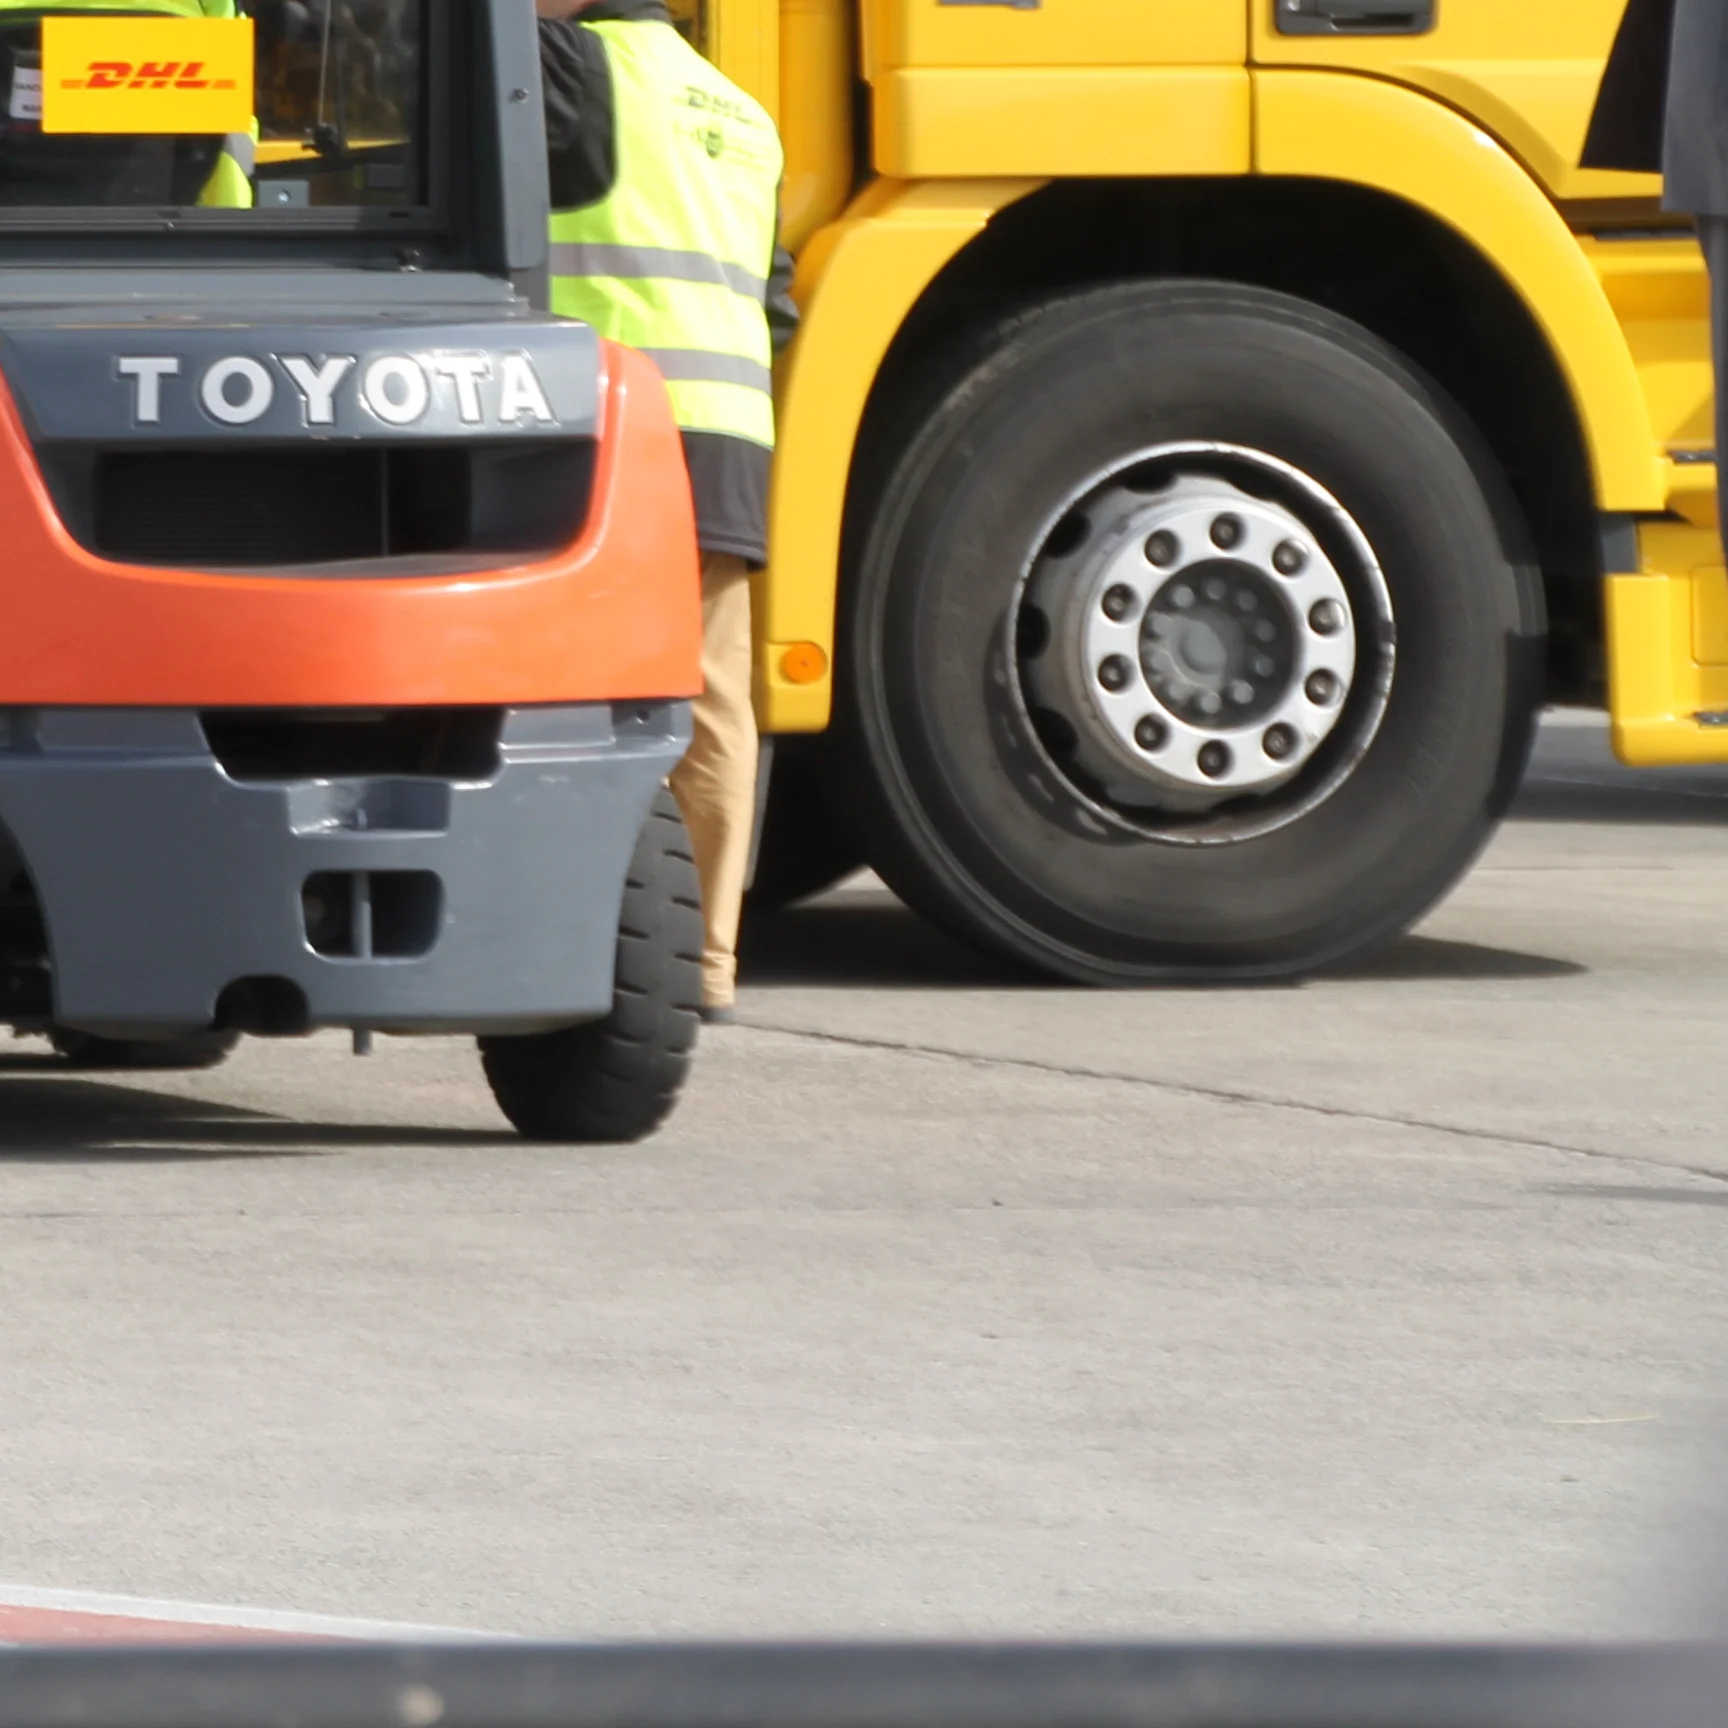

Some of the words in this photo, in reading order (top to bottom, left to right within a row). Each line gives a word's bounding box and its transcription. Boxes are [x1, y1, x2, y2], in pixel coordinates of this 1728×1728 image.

[85, 61, 210, 90] DHL
[686, 86, 752, 124] DHL
[119, 354, 556, 425] TOYOTA
